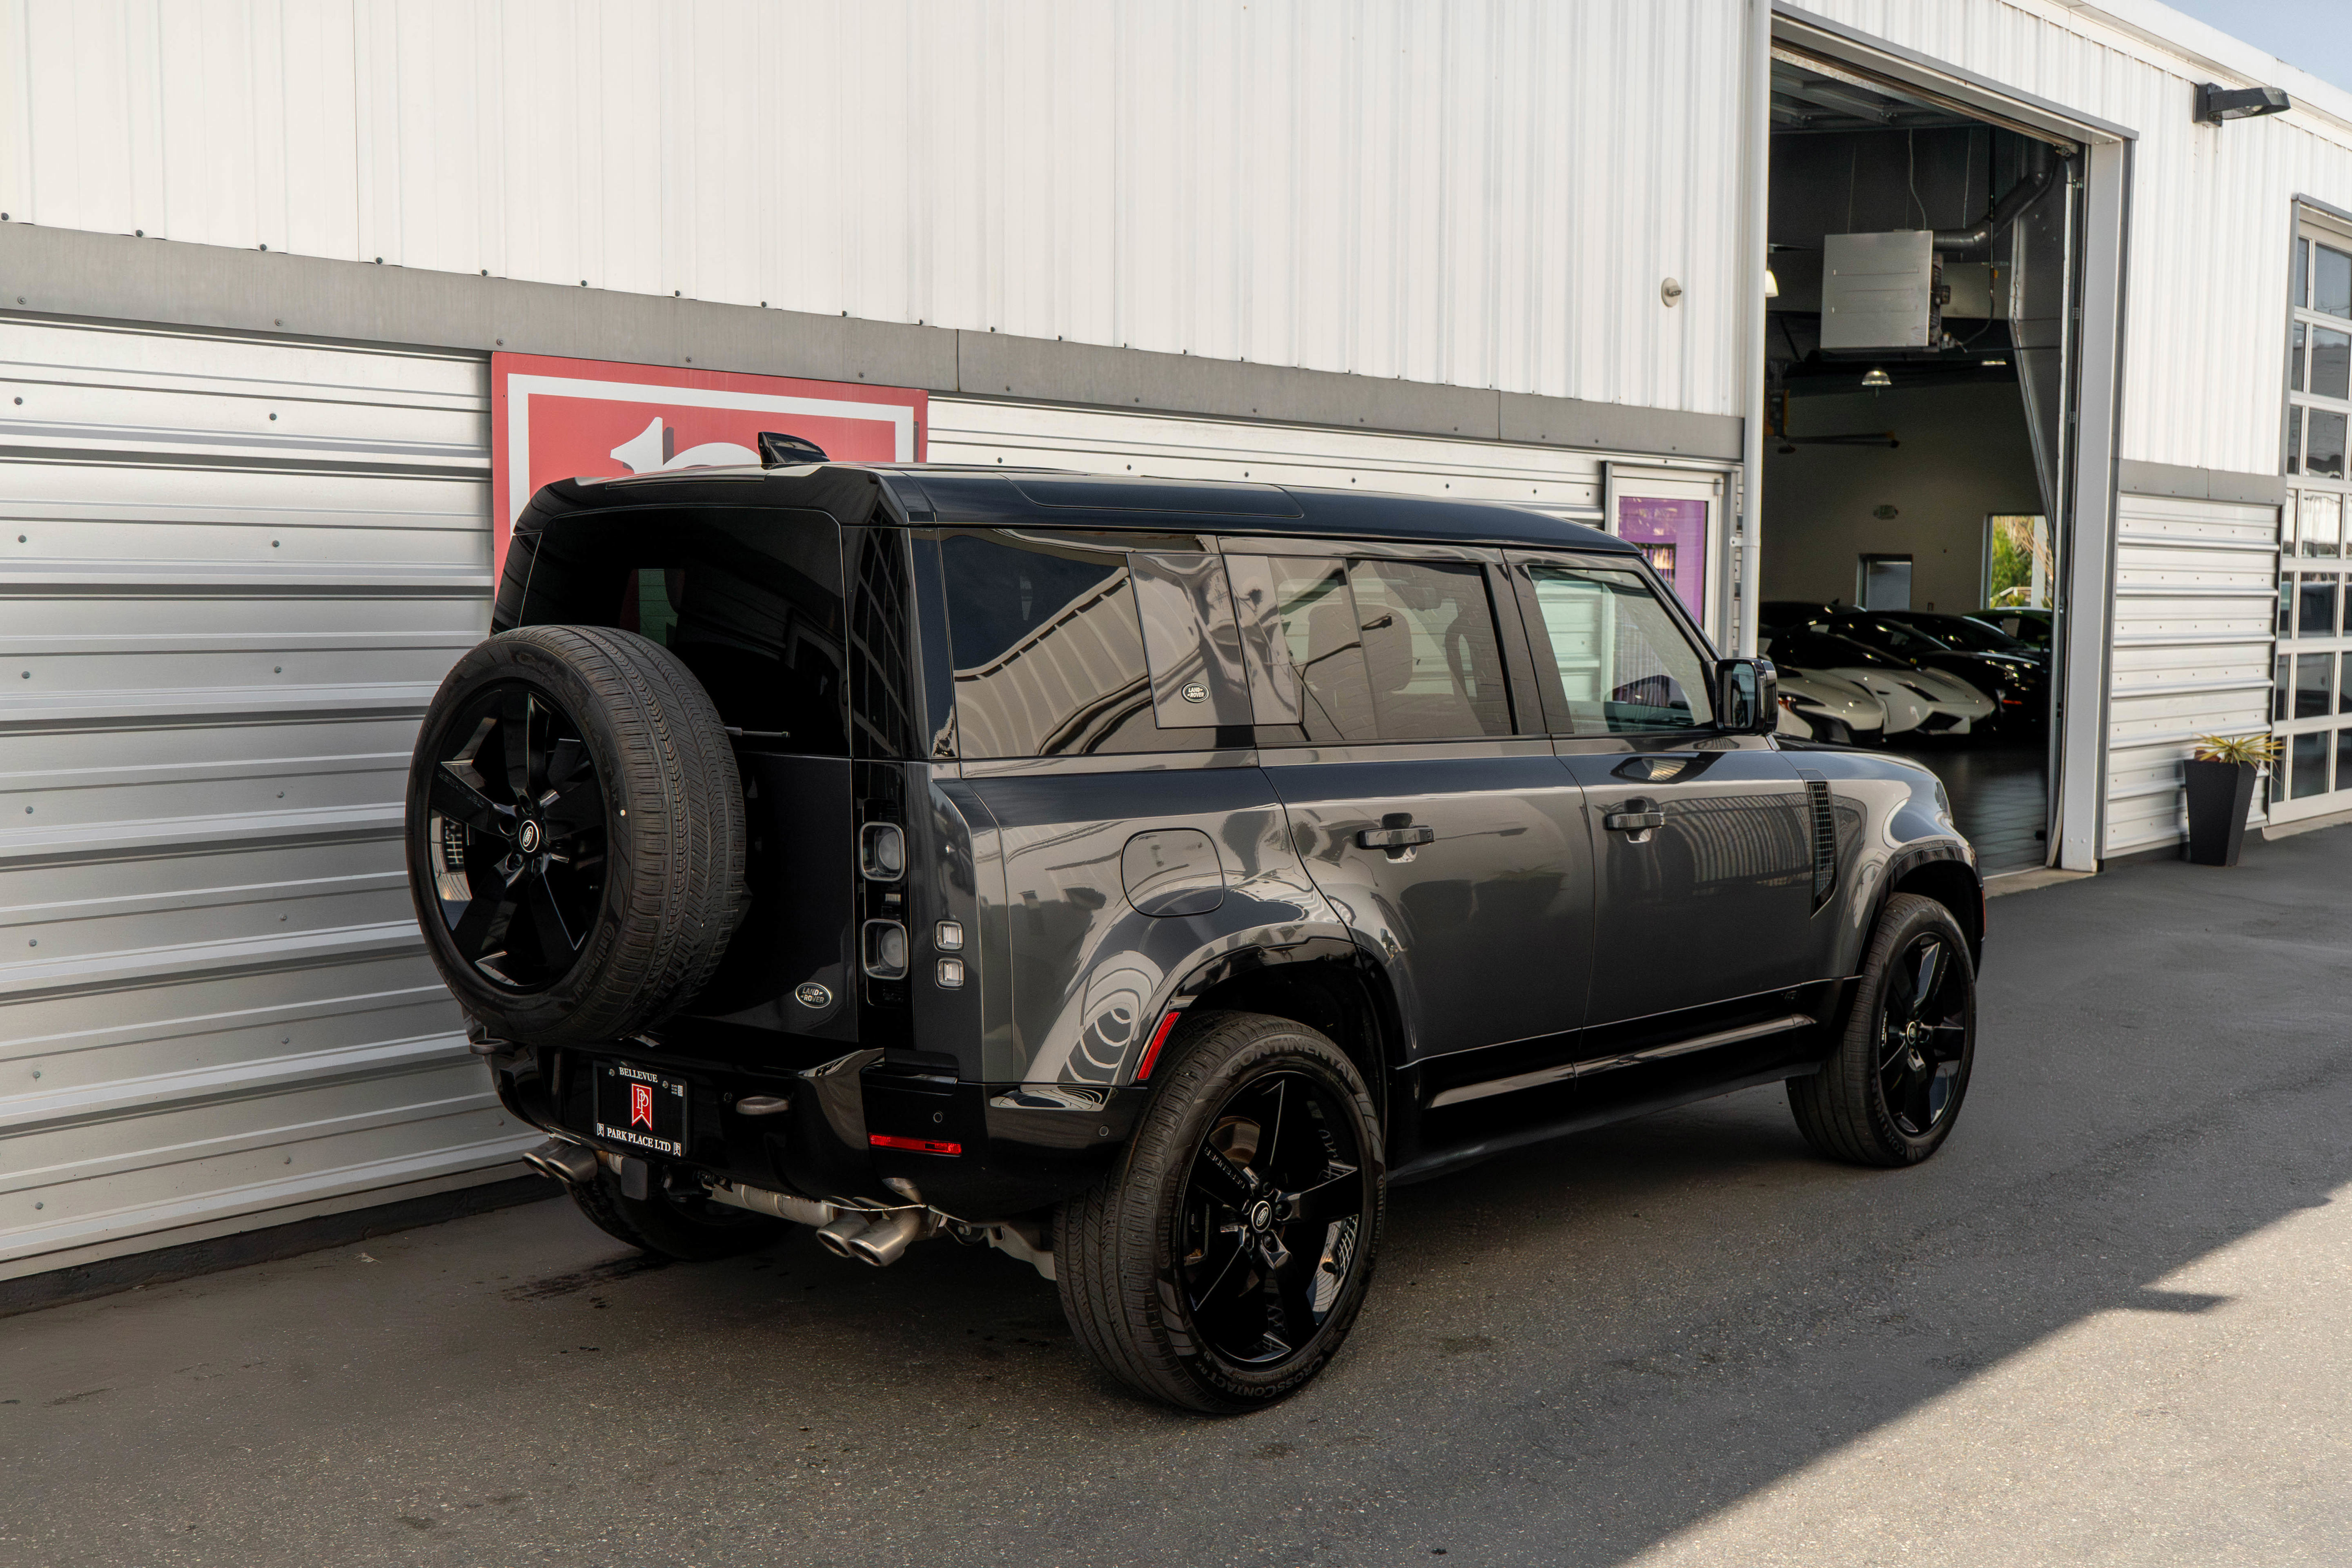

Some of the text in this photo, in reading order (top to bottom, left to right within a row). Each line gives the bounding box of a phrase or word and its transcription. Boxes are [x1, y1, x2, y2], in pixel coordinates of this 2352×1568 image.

[802, 987, 819, 996] LAND
[804, 995, 824, 1004] ROVER
[1227, 1038, 1357, 1094] CONTINENTAL
[619, 1067, 658, 1082] BELLEVUE
[607, 1127, 671, 1152] PARK PLACE LTD
